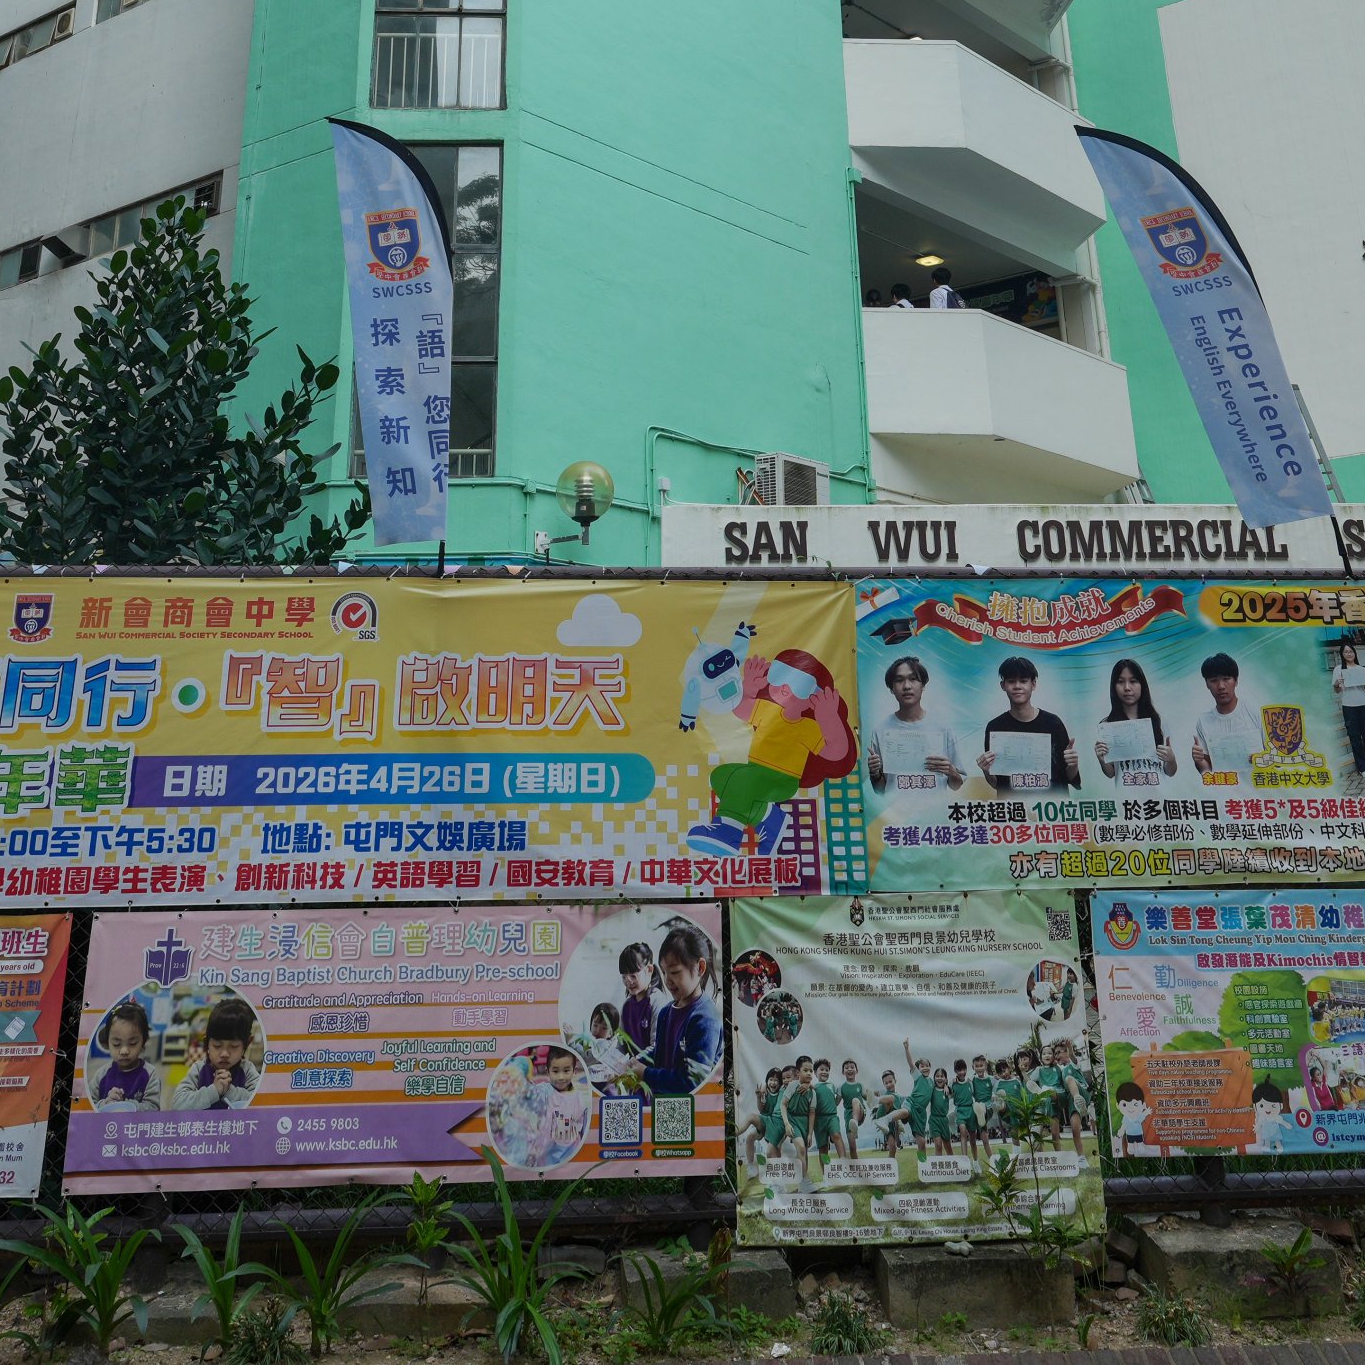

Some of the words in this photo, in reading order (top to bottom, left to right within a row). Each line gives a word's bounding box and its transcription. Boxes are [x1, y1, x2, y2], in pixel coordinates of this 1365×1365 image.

[372, 282, 432, 298] SWCSSS
[1172, 275, 1233, 297] SWCSSS
[1190, 315, 1223, 376] English
[1217, 379, 1268, 483] Everywhere
[1217, 307, 1302, 477] Experience
[370, 317, 416, 498] 探索新知
[724, 520, 809, 564] SAN
[868, 520, 959, 563] WUI
[1017, 519, 1288, 563] COMMERCIAL
[78, 597, 315, 628] 新會商會中學
[988, 588, 1111, 625] 擁抱成就
[936, 603, 993, 636] Cherish
[996, 627, 1056, 643] Student
[1059, 598, 1155, 642] Achievements
[358, 630, 376, 640] SGS
[164, 766, 227, 798] 日期
[256, 763, 491, 797] 2026年4月26日
[503, 763, 620, 798] (星期日)
[1253, 771, 1331, 787] 香港中文大學
[947, 802, 1027, 823] 本校超過
[1032, 800, 1117, 822] 10位同學
[1122, 800, 1219, 822] 於多個科目
[262, 821, 333, 854] 地點:
[342, 819, 527, 852] 屯門文娛廣場
[372, 860, 480, 890] 英語學習
[506, 859, 614, 888] 國安教育
[640, 855, 802, 887] 中華文化展板
[200, 921, 562, 961] 建生浸信會白普理幼兒園
[776, 947, 798, 955] HONG
[800, 947, 822, 955] KONG
[823, 947, 848, 955] SHENG
[1149, 936, 1168, 945] Lok
[1170, 935, 1187, 945] Sin
[1189, 936, 1213, 947] Tong
[1215, 935, 1253, 947] Cheung
[1255, 935, 1273, 947] Yip
[1274, 935, 1296, 945] Mou
[1297, 934, 1327, 946] Ching
[199, 969, 225, 986] Kin
[231, 969, 270, 987] Sang
[276, 966, 333, 986] Baptist
[337, 966, 392, 983] Church
[399, 965, 471, 985] Bradbury
[474, 962, 559, 982] Pre-school
[1108, 964, 1133, 991] 仁
[1153, 964, 1176, 990] 勤
[263, 994, 321, 1010] Gratitude
[323, 993, 346, 1008] and
[348, 991, 424, 1008] Appreciation
[431, 991, 485, 1004] Hands-on
[488, 990, 535, 1005] Learning
[1109, 992, 1167, 1001] Benevolence
[1174, 993, 1194, 1016] 誠
[308, 1012, 370, 1033] 感恩珍惜
[452, 1008, 508, 1026] 動手學習
[1136, 1006, 1156, 1031] 愛
[264, 1050, 314, 1064] Creative
[316, 1049, 375, 1065] Discovery
[381, 1039, 418, 1056] Joyful
[420, 1039, 471, 1056] Learning
[474, 1038, 497, 1052] and
[393, 1058, 417, 1072] Self
[419, 1058, 485, 1072] Confidence
[291, 1068, 353, 1089] 創意探索
[405, 1075, 465, 1095] 樂學自信
[297, 1118, 327, 1131] 2455
[330, 1117, 360, 1130] 9803
[121, 1142, 231, 1157] ksbc@ksbc.edu.hk
[295, 1137, 398, 1152] www.ksbc.edu.hk
